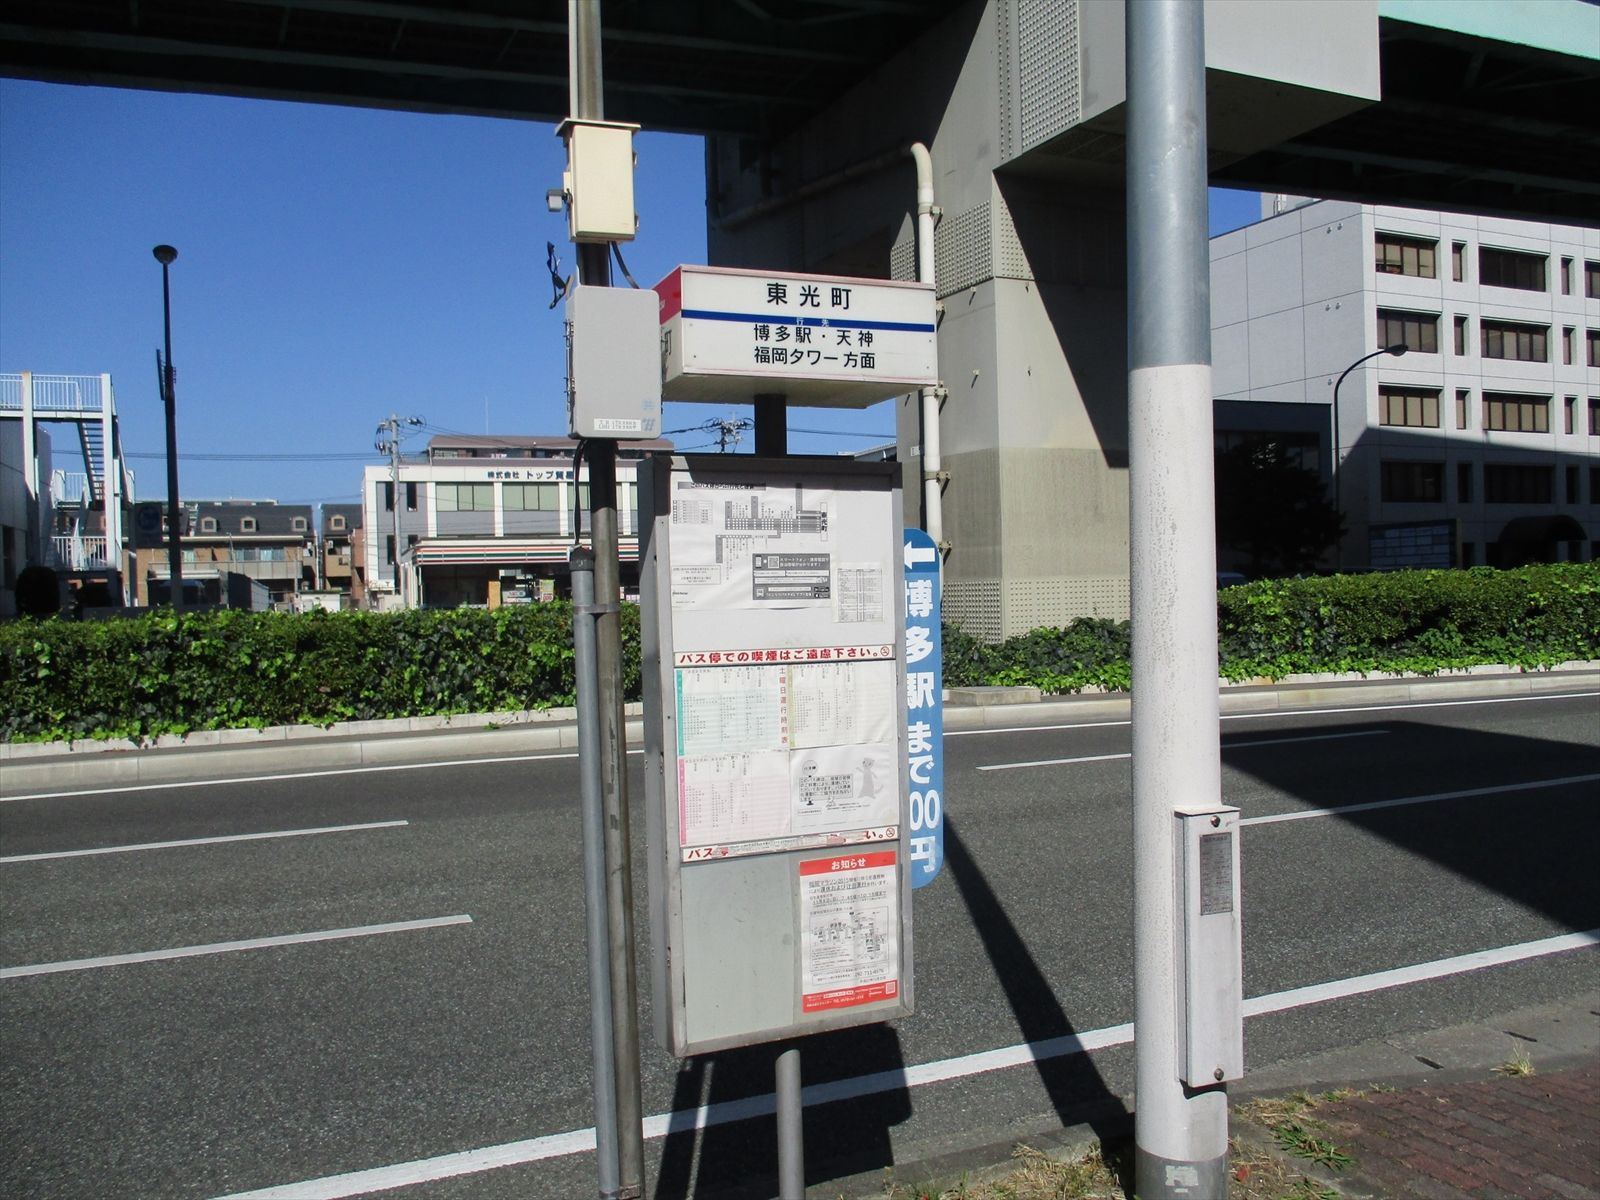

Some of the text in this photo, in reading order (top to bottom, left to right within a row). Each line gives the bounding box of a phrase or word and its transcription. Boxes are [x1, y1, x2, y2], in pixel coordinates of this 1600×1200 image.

[766, 282, 853, 310] 東光町
[753, 324, 875, 348] 博多駅・天神
[753, 346, 876, 369] 福岡タワー方面
[680, 647, 878, 664] バス停での喫煙はご遠慮下さい。
[831, 857, 867, 870] お知らせ
